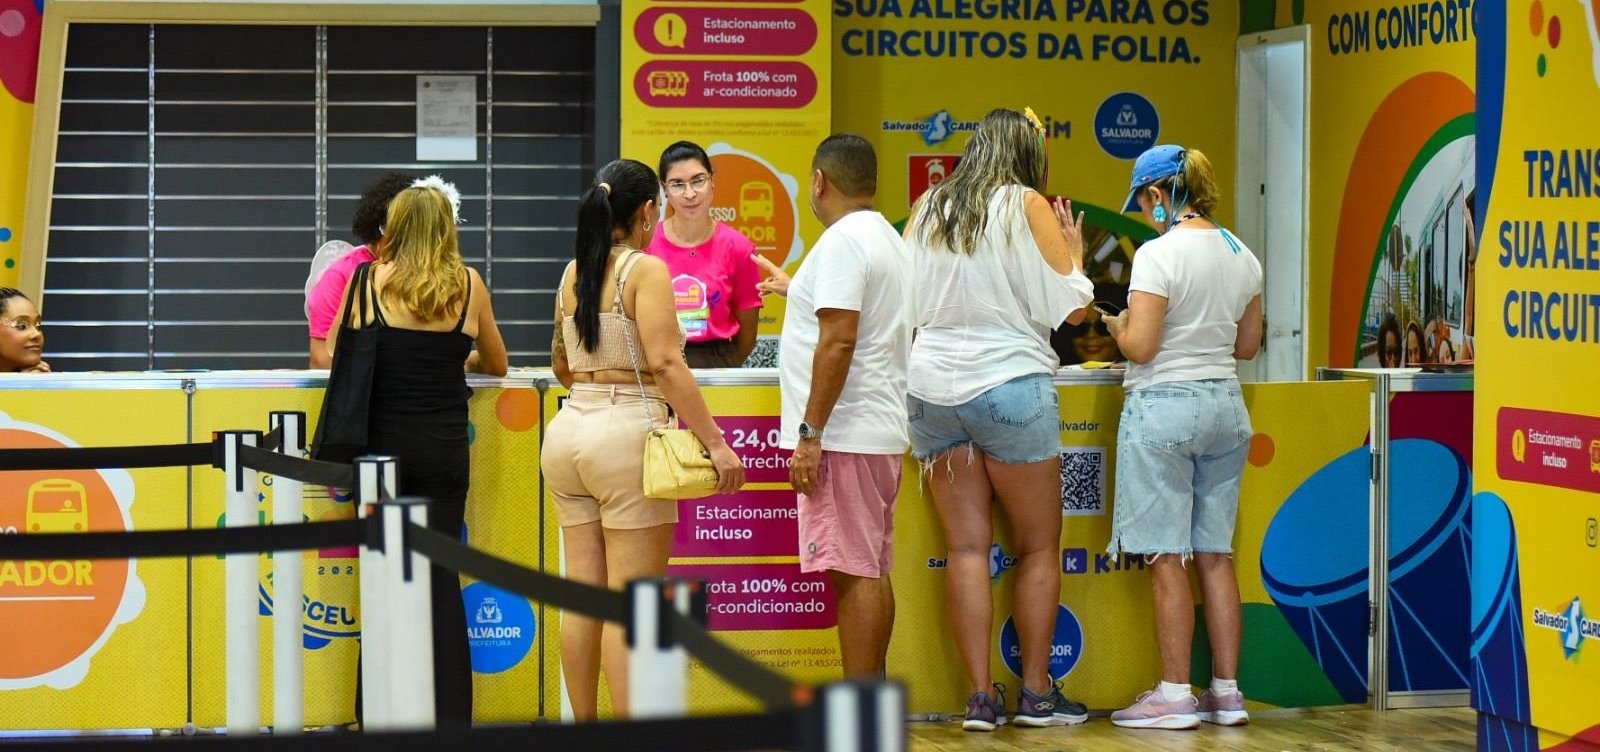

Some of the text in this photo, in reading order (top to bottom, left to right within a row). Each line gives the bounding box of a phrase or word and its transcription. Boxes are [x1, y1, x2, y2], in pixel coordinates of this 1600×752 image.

[834, 0, 1210, 26] SUA ALEGRIA PARA OS
[703, 17, 796, 30] Estacionamento
[703, 33, 745, 44] incluso
[1328, 11, 1370, 55] COM
[842, 29, 1201, 64] CIRCUITOS DA FOLIA.
[703, 71, 797, 82] Frota 100% com
[703, 87, 797, 97] ar-condicionado
[882, 121, 930, 131] Salvador
[1102, 127, 1151, 138] SALVADOR
[1498, 220, 1600, 271] SUA ALE
[1503, 289, 1600, 343] CIRCUIT
[1058, 420, 1099, 431] lvador
[1528, 429, 1582, 449] Estacionamento
[1542, 451, 1567, 468] incluso
[696, 505, 797, 520] Estacioname
[695, 526, 753, 540] incluso
[0, 560, 94, 587] ADOR
[741, 579, 787, 593] 100%
[791, 581, 825, 593] com
[1534, 609, 1568, 630] Salvador
